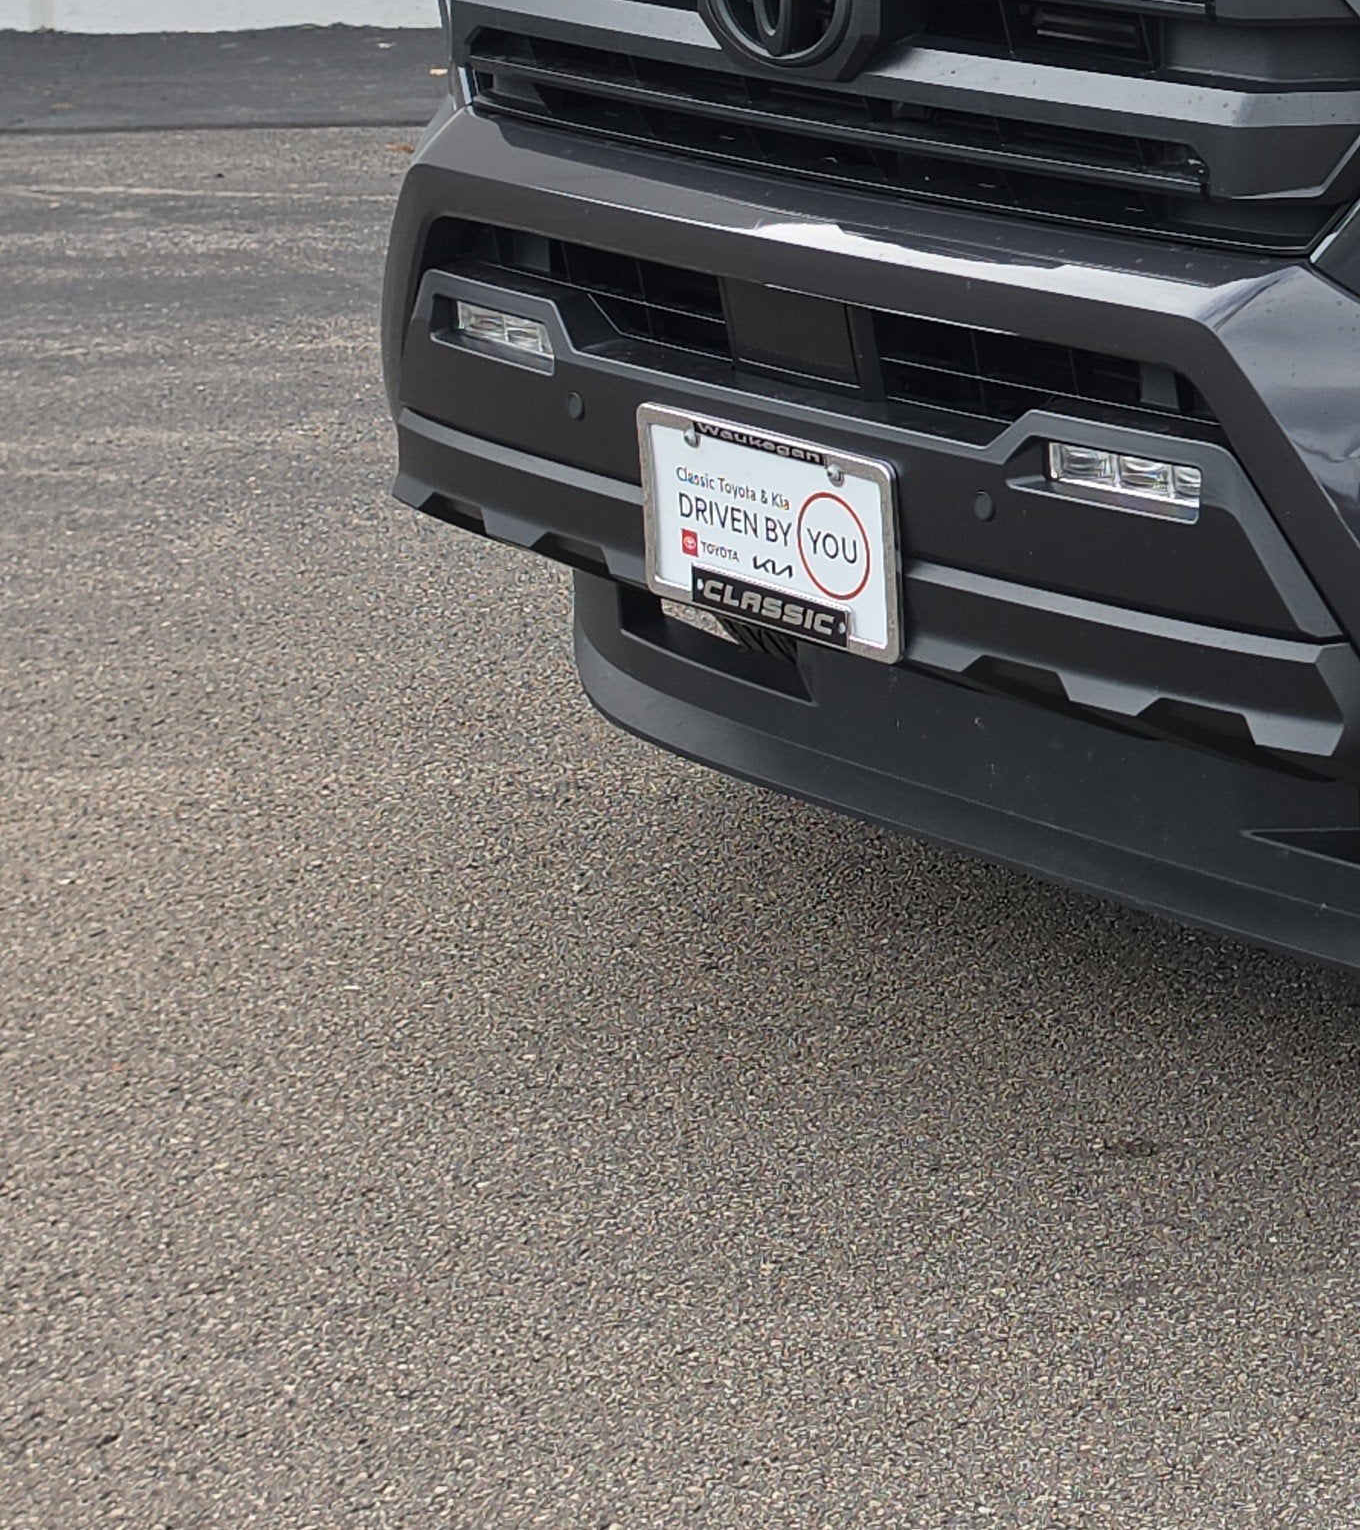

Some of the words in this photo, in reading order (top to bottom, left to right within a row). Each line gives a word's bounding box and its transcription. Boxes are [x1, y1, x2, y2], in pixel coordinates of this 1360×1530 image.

[696, 421, 821, 464] Waukegan
[676, 466, 714, 491] Classic
[717, 477, 756, 501] Toyota
[761, 489, 768, 505] &
[771, 491, 790, 511] Kia
[679, 491, 758, 538] DRIVEN
[764, 515, 792, 547] BY
[806, 528, 858, 564] YOU
[701, 540, 739, 562] TOYOTA
[702, 578, 835, 636] CLASSIC
